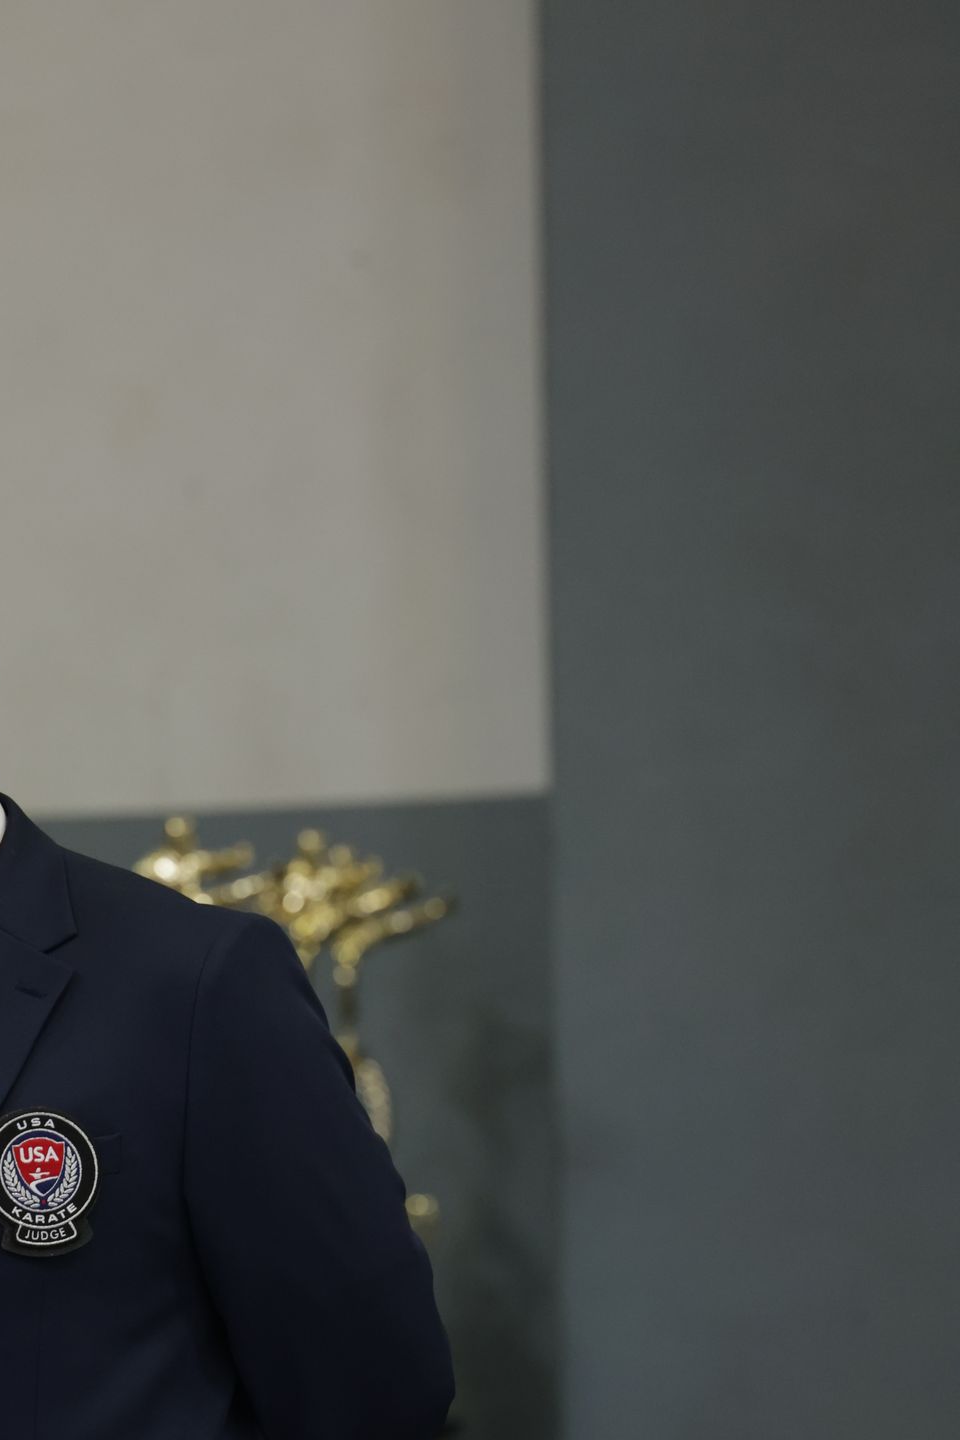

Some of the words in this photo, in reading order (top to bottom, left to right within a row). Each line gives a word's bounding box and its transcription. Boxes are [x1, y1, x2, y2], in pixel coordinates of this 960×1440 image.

[16, 1117, 56, 1131] USA
[19, 1145, 59, 1164] USA
[11, 1202, 78, 1224] KARATE
[24, 1227, 67, 1241] JUDGE
